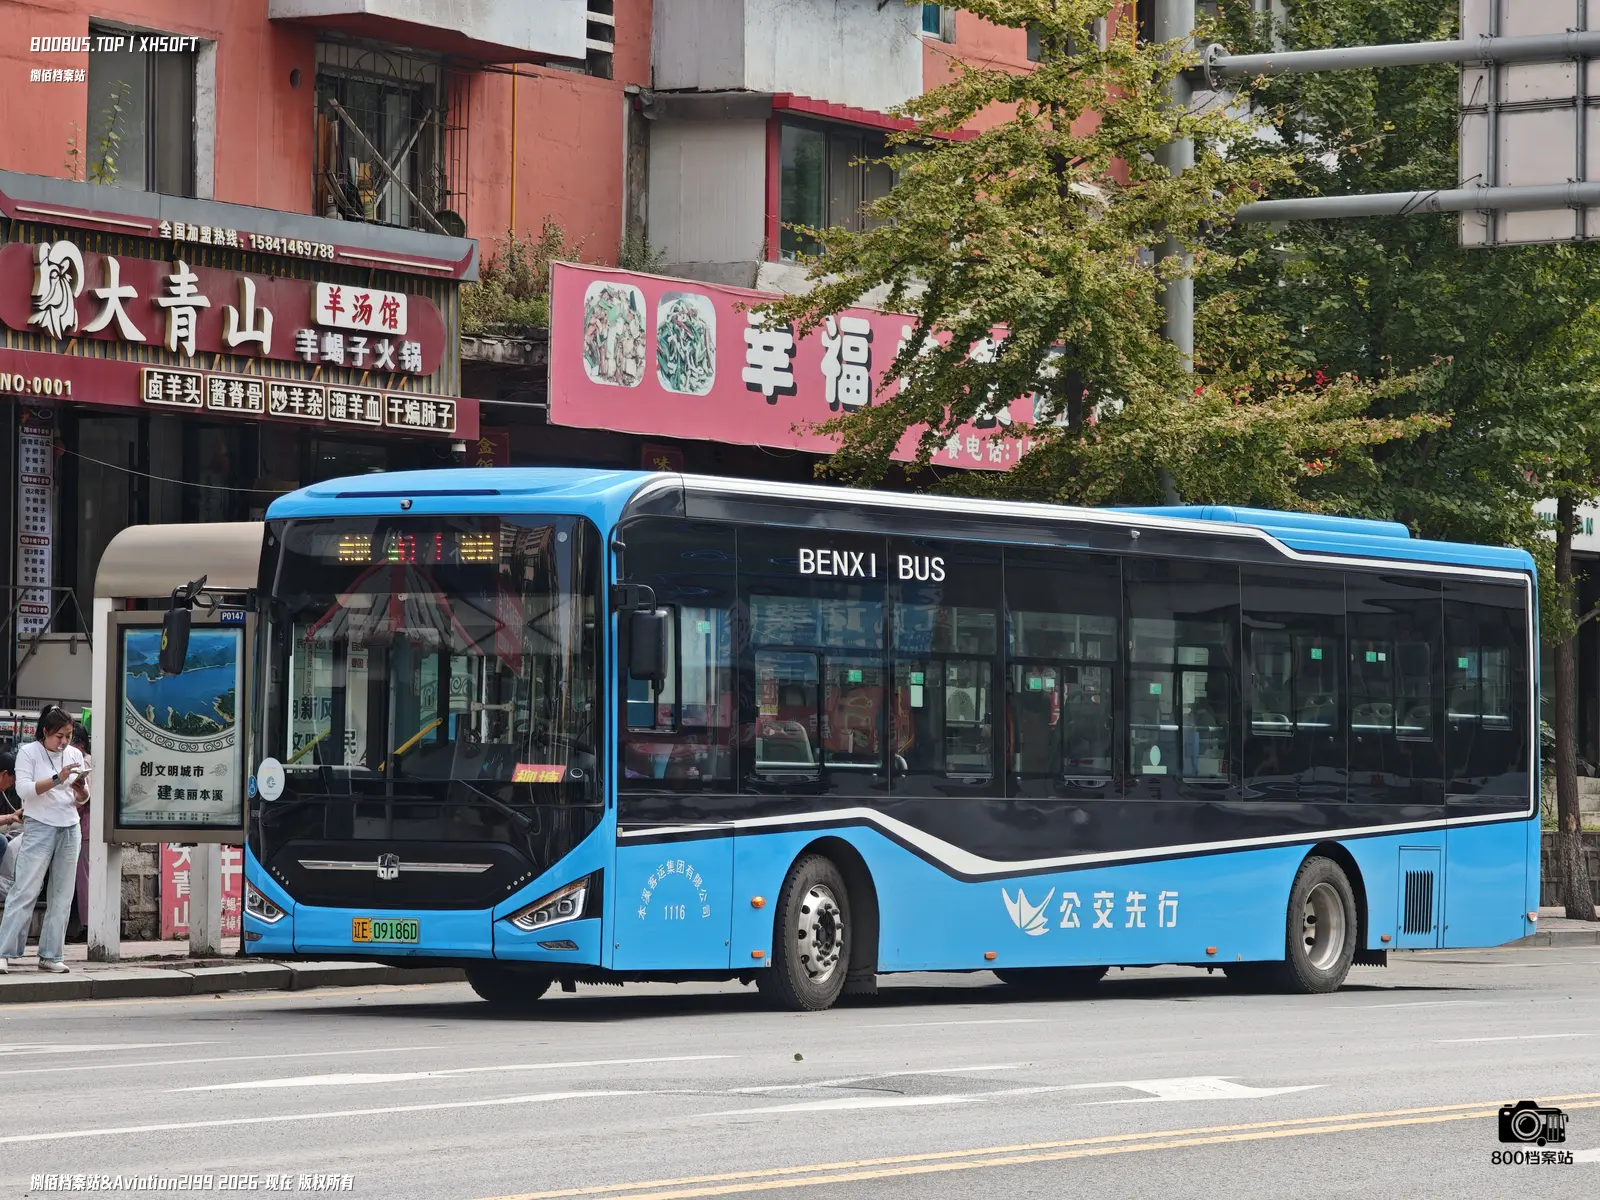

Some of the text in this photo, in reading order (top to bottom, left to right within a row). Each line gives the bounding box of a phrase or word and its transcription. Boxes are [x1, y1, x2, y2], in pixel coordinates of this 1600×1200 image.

[250, 234, 334, 259] 15841469788
[81, 256, 274, 357] 大青山
[324, 286, 400, 329] 羊汤馆
[295, 329, 422, 373] 羊蝎子火锅
[0, 372, 72, 396] NO:0001
[148, 373, 453, 428] 卤羊头 酱脊骨 炒羊杂 溜羊血 干煸肺子
[799, 548, 946, 582] BENXI BUS
[222, 612, 244, 620] P0147
[140, 761, 204, 777] 创文明城市
[157, 784, 223, 801] 建美丽本溪
[664, 904, 686, 920] 1116
[1059, 890, 1179, 929] 公交先行
